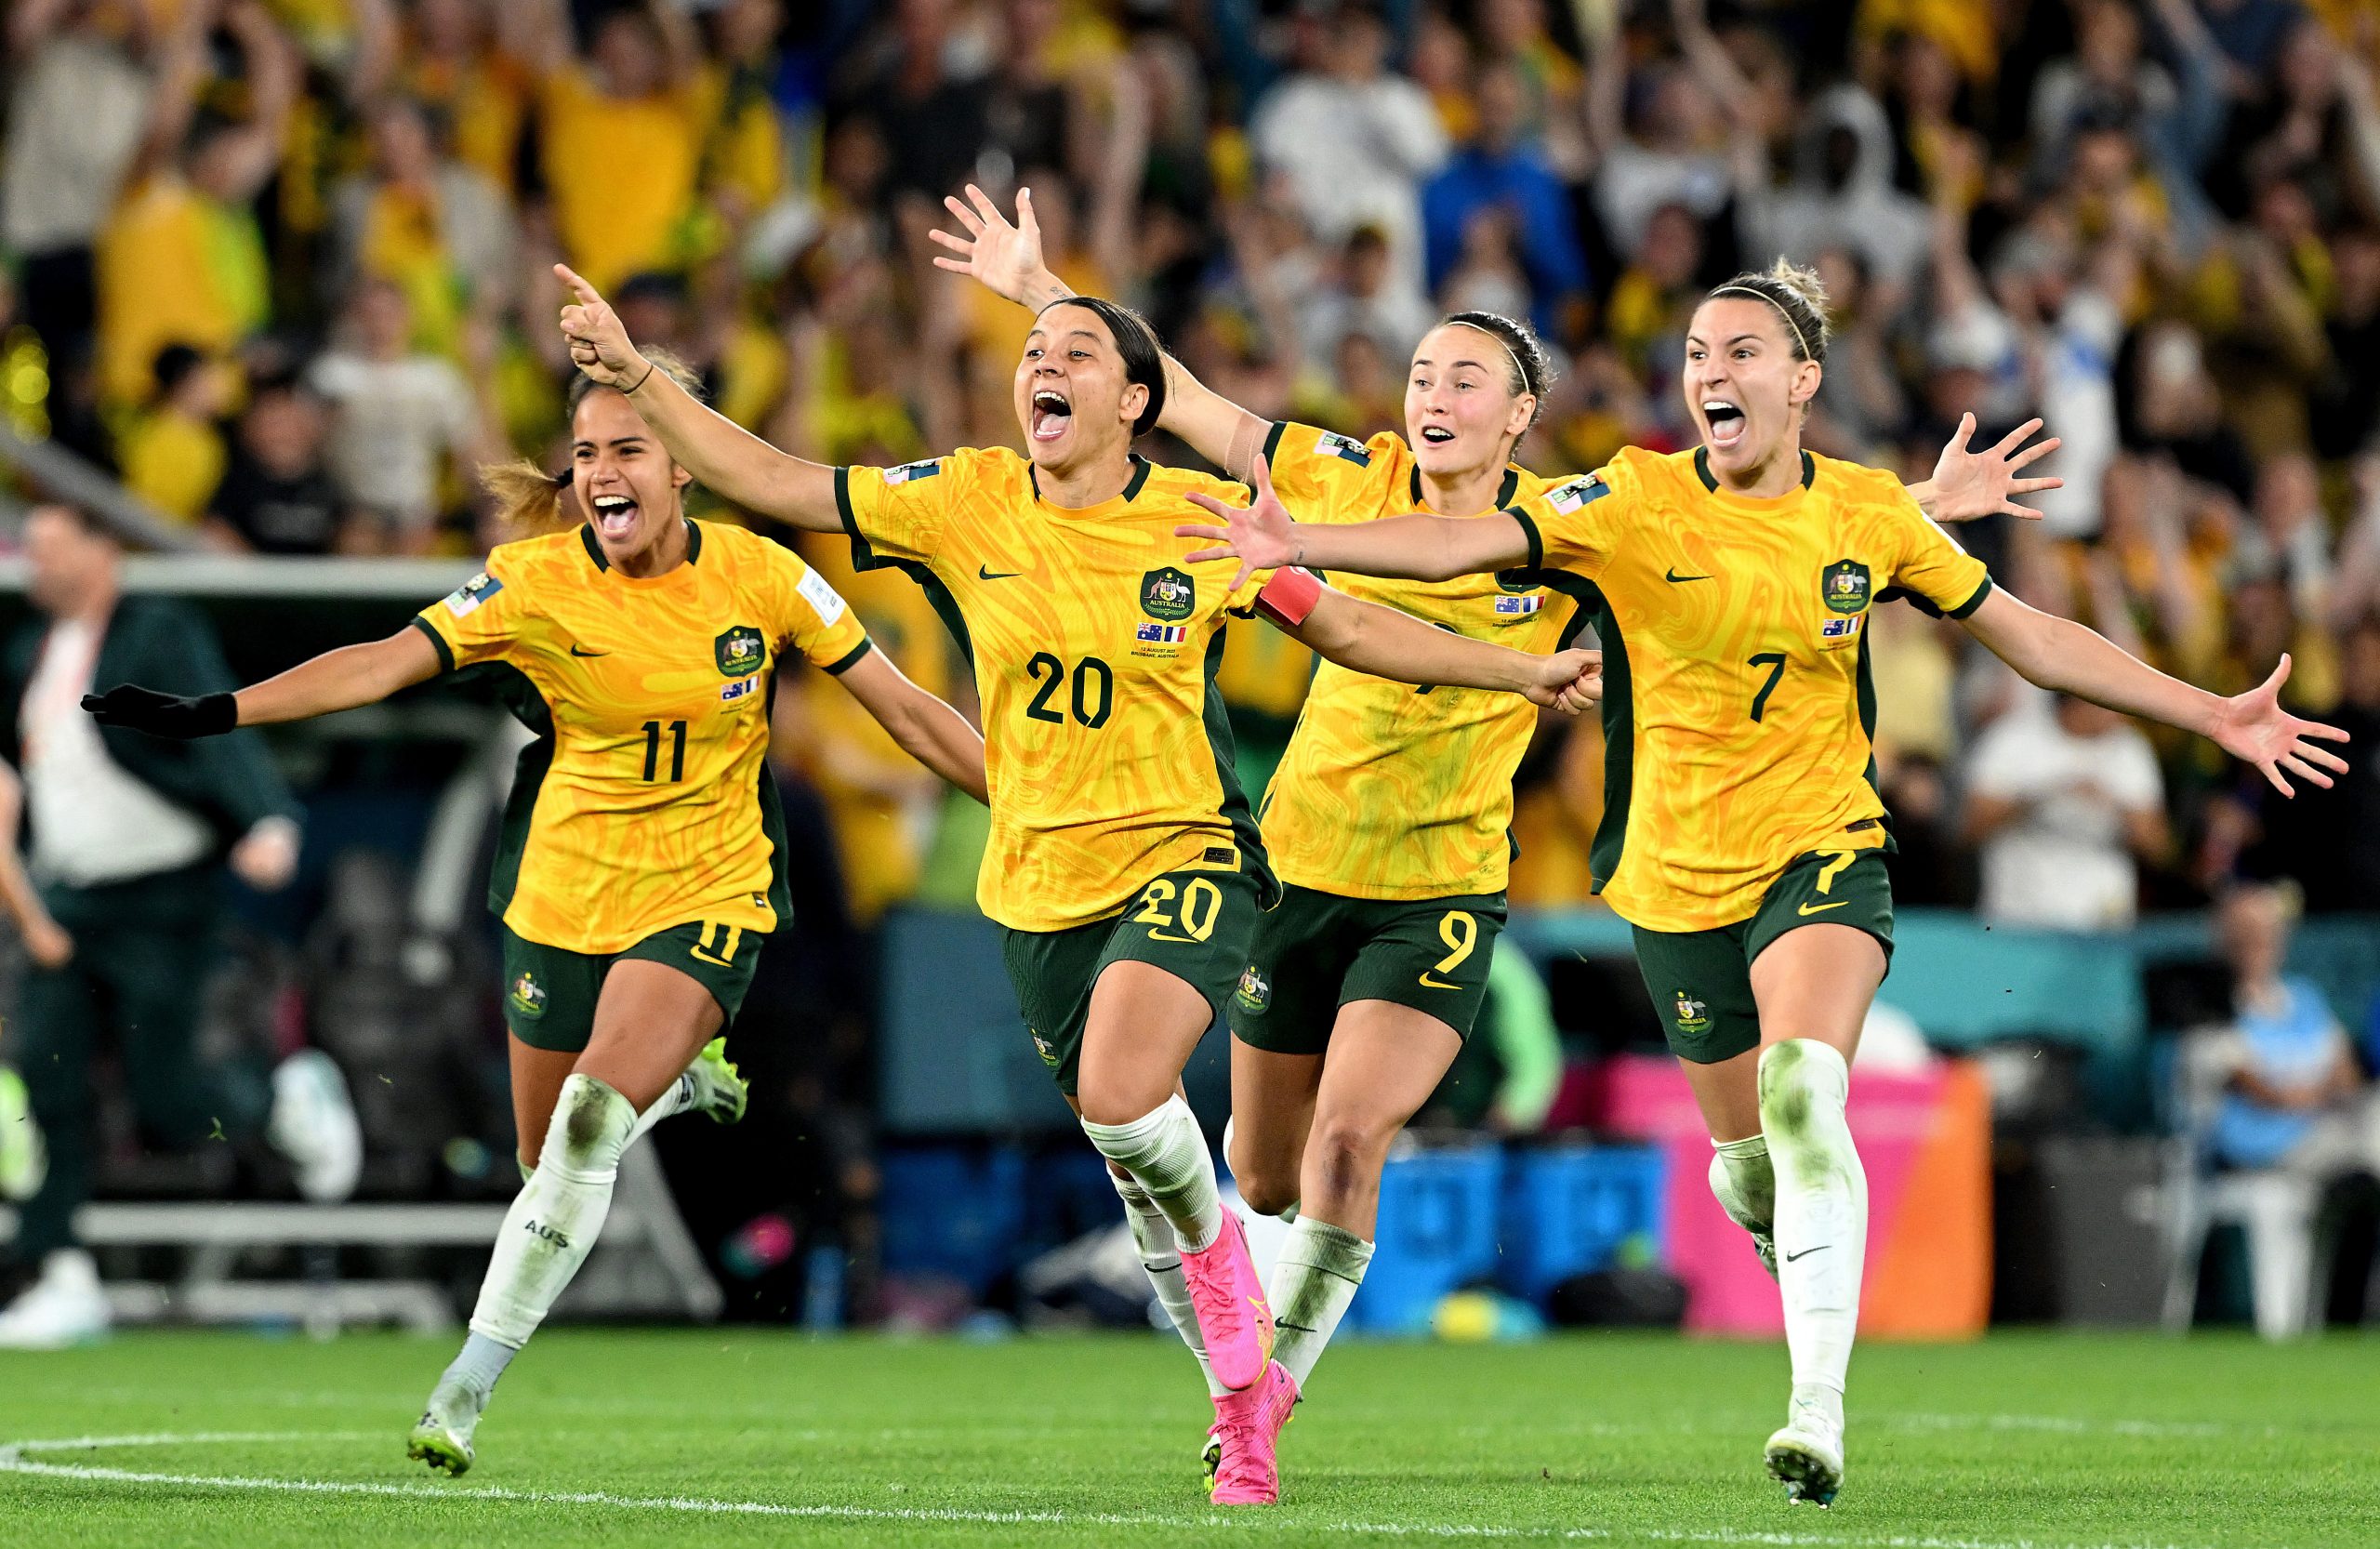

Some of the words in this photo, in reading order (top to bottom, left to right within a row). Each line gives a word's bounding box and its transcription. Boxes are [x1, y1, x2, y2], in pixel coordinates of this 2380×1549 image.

[1149, 600, 1185, 608] AUSTRALIA
[1025, 651, 1114, 730] 20
[1747, 652, 1787, 724] 7
[641, 720, 688, 783] 11
[1815, 849, 1858, 895] 7
[1132, 877, 1223, 943] 20
[1434, 910, 1477, 974] 9
[524, 1220, 569, 1248] AUS
